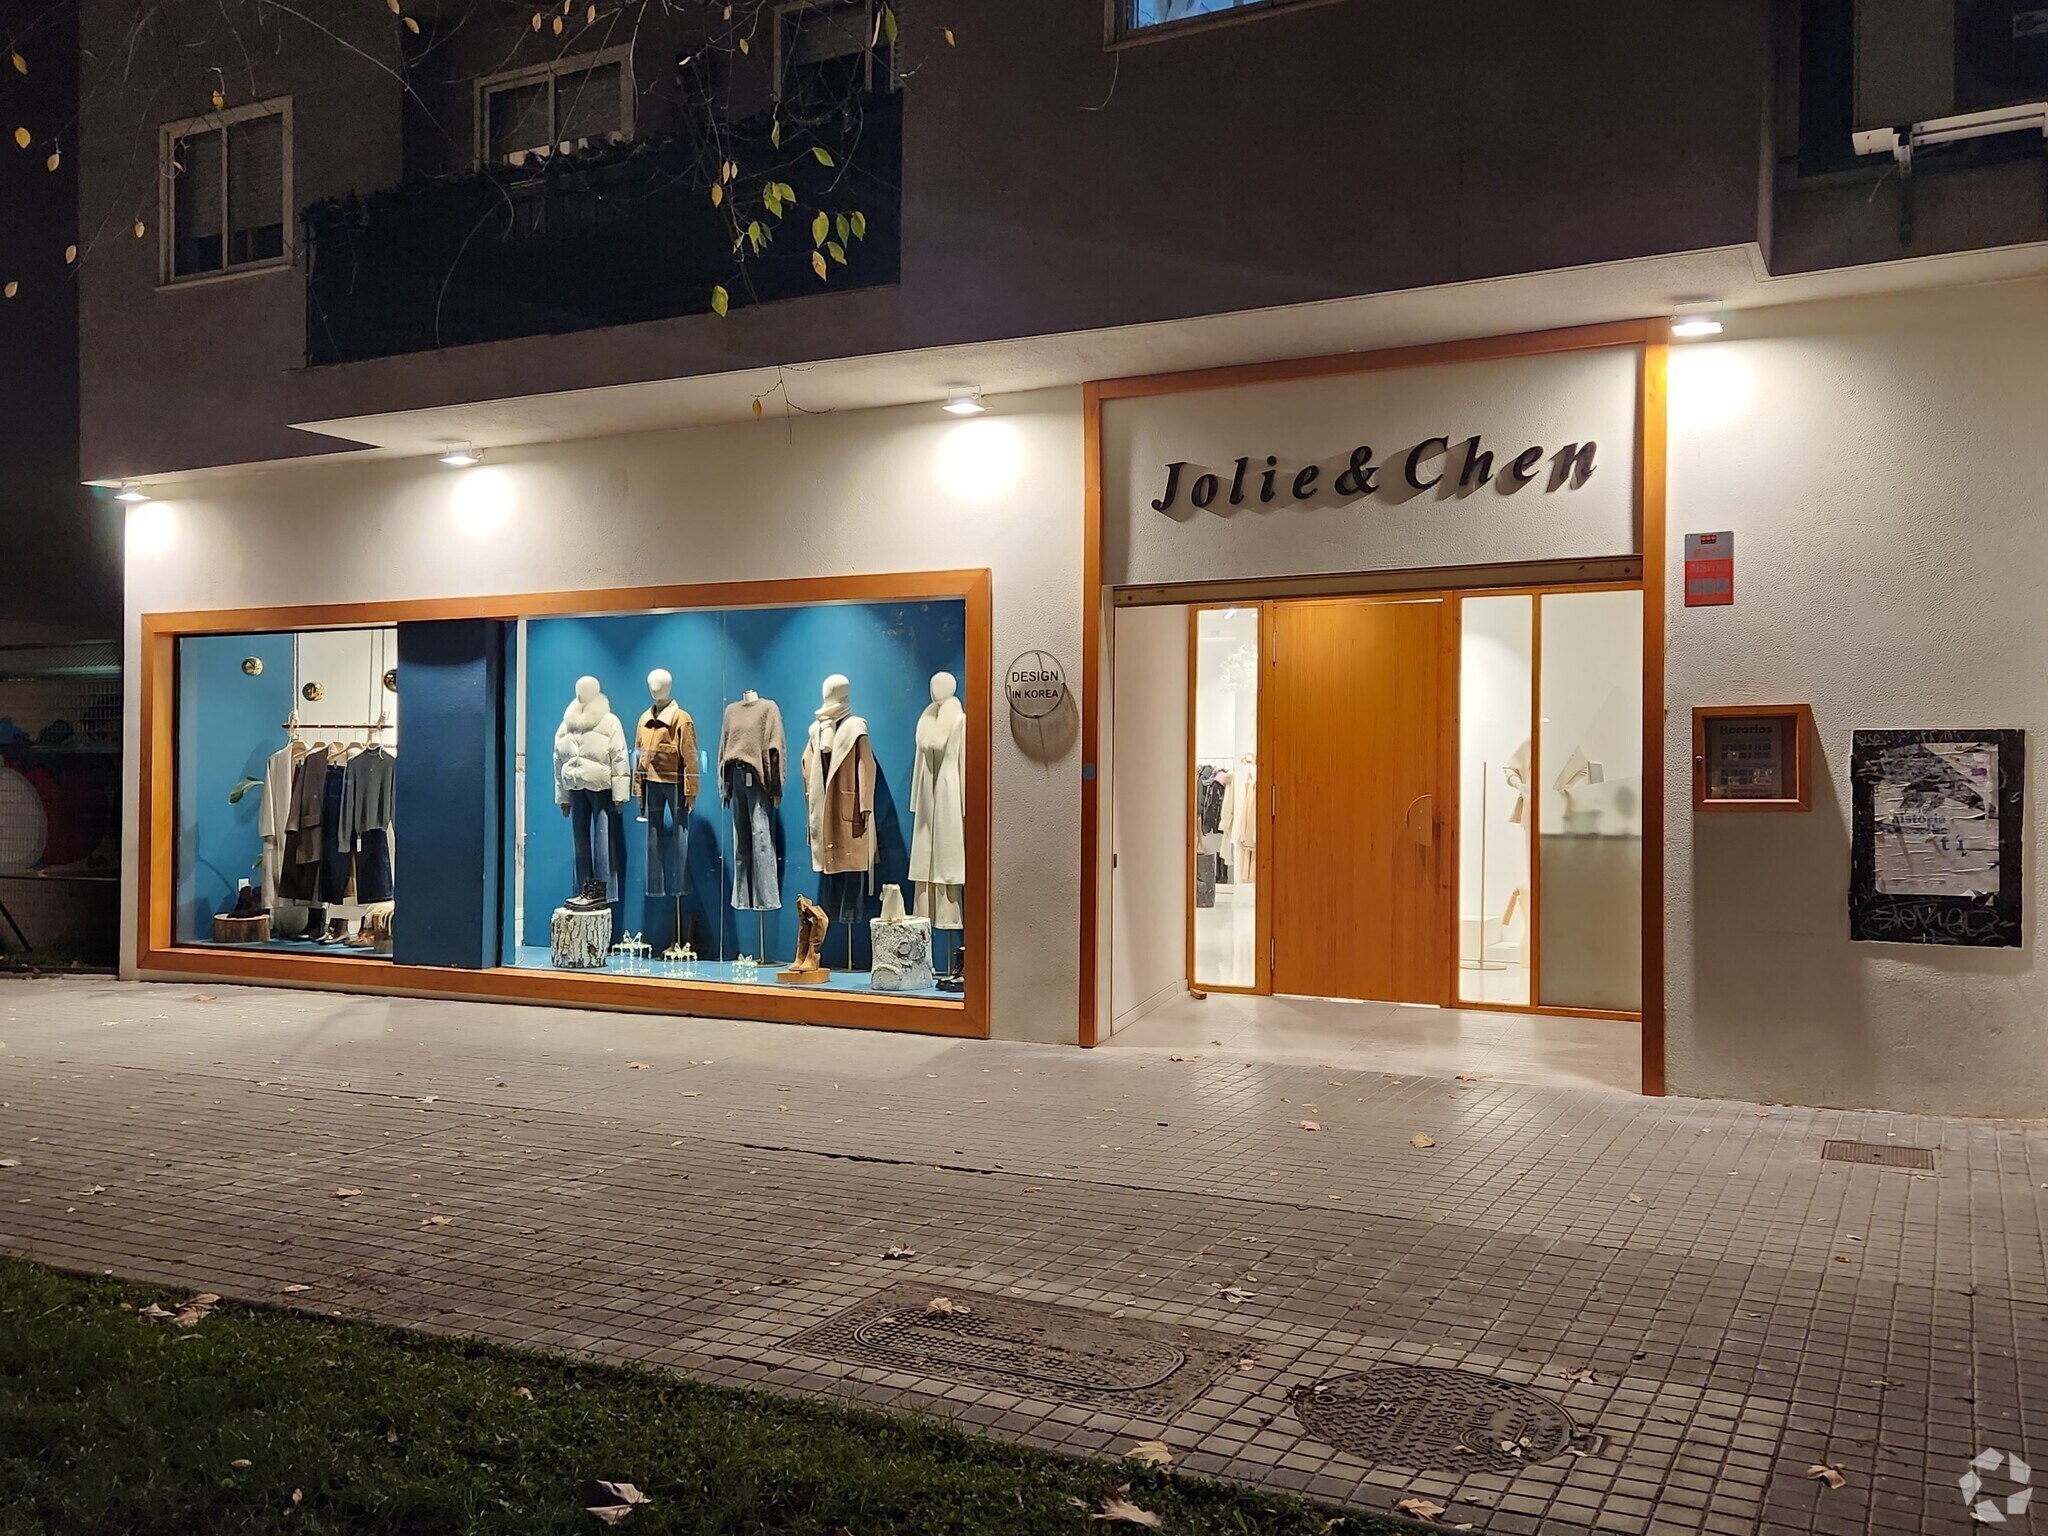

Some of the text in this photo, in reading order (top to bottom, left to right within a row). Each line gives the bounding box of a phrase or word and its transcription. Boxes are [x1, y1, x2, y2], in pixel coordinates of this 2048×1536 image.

[1151, 435, 1598, 511] Jolie & Chen
[1011, 670, 1059, 682] DESIGN
[1012, 689, 1059, 699] IN KOREA
[1720, 724, 1773, 735] Horarios
